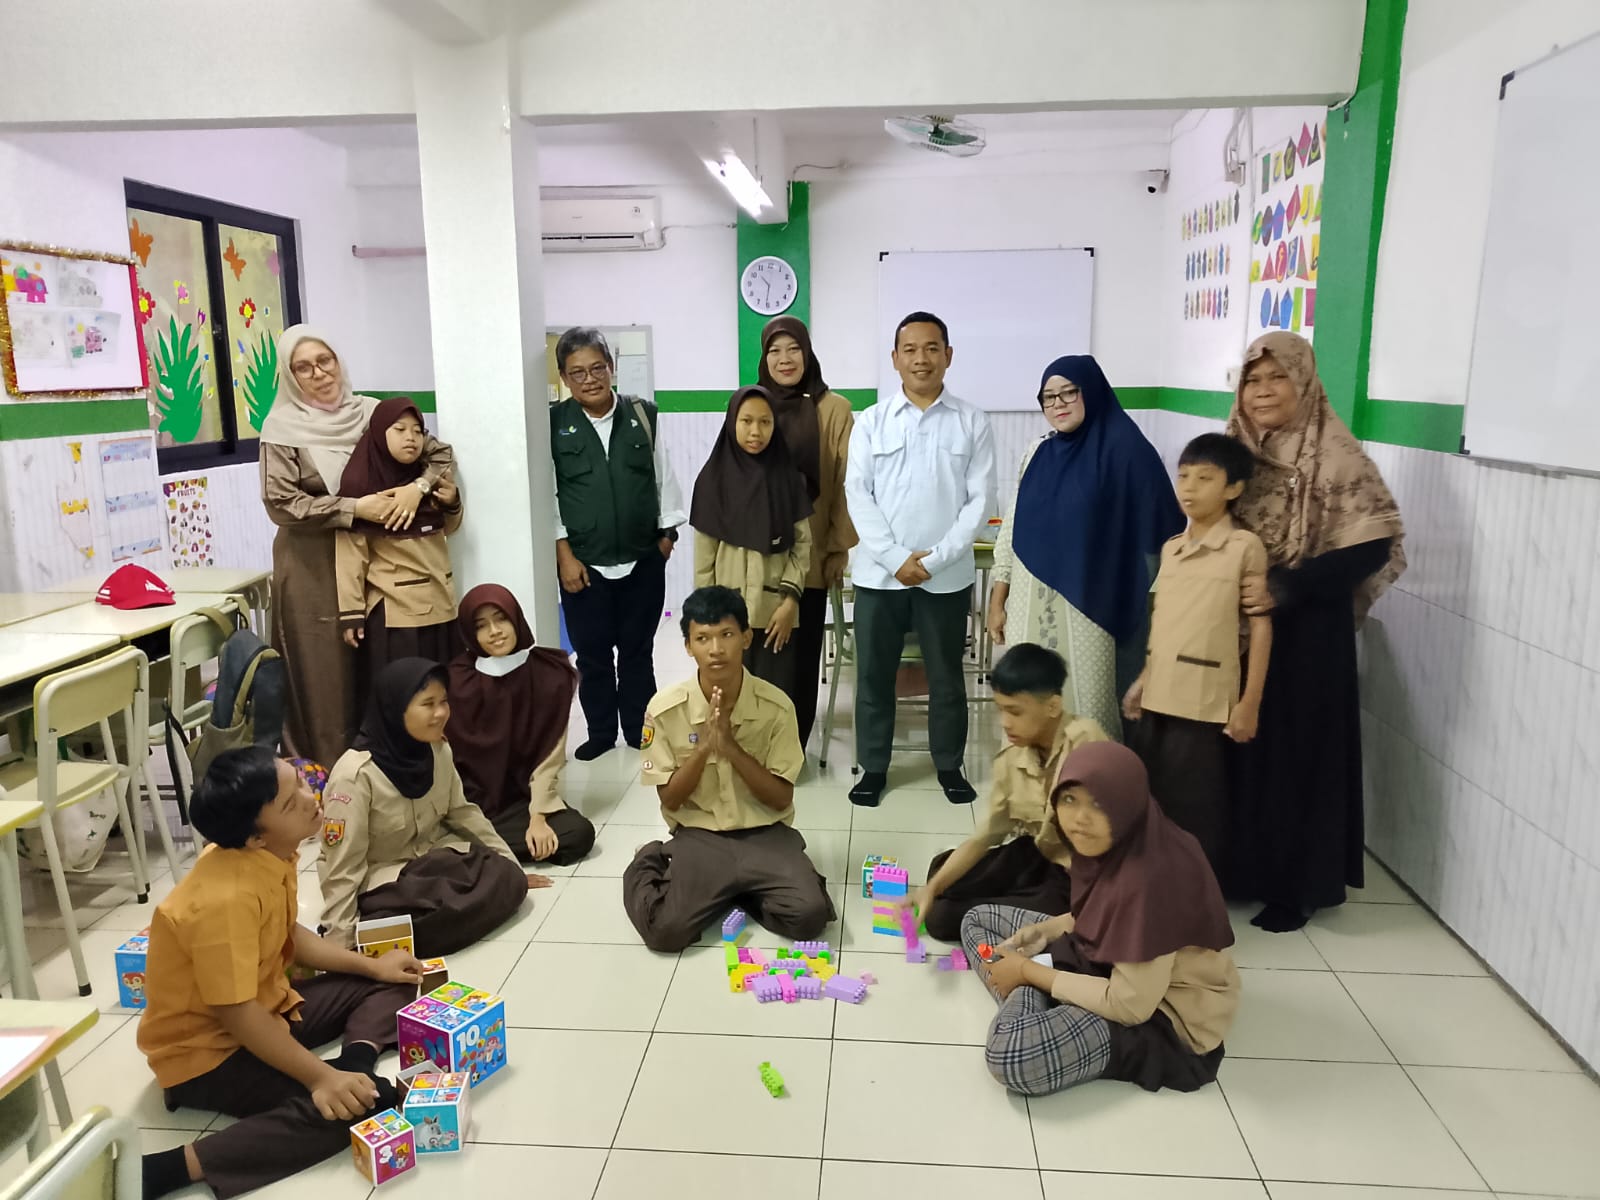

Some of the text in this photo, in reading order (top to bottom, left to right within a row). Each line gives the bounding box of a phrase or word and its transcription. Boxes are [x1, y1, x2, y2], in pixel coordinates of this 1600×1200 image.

[177, 488, 196, 497] FRUITS
[456, 1024, 480, 1053] 10
[378, 1145, 393, 1164] 3
